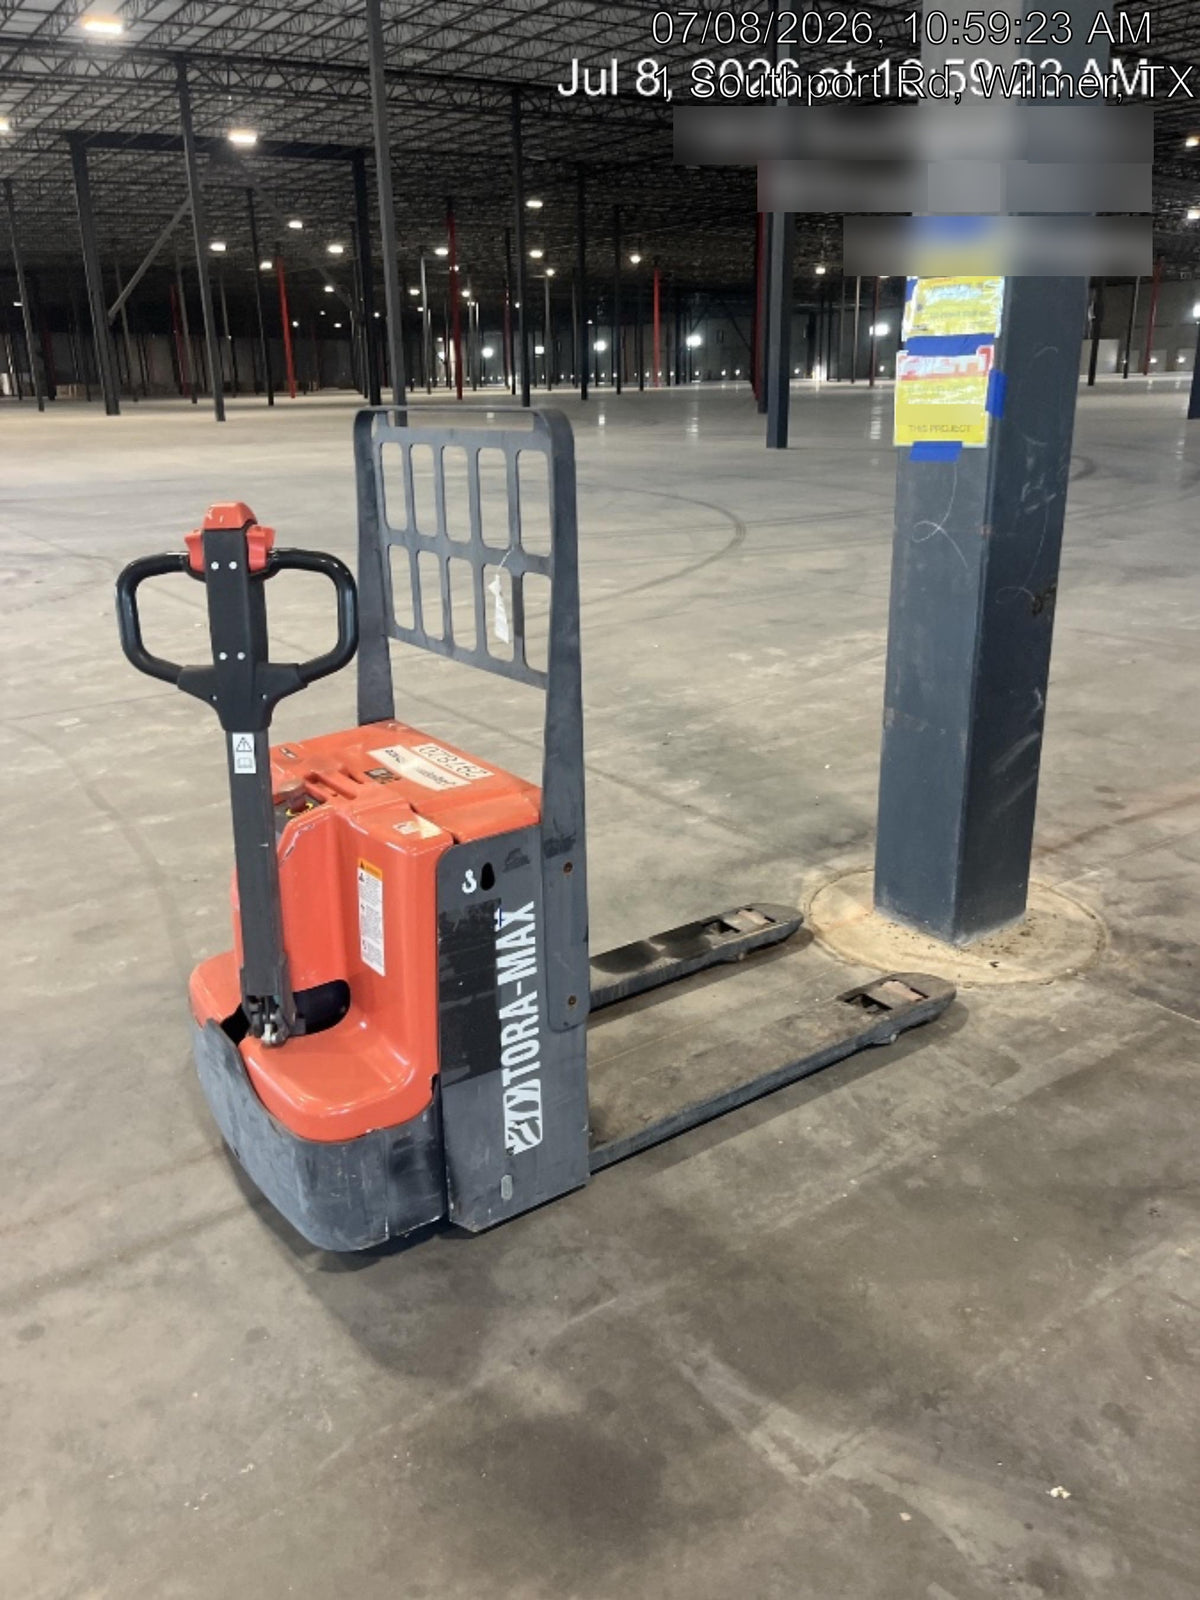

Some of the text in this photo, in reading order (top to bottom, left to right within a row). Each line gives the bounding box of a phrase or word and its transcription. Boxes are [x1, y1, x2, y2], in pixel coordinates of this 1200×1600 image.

[908, 424, 972, 433] THIS PROJECT
[494, 900, 541, 1087] TORA-MAX
